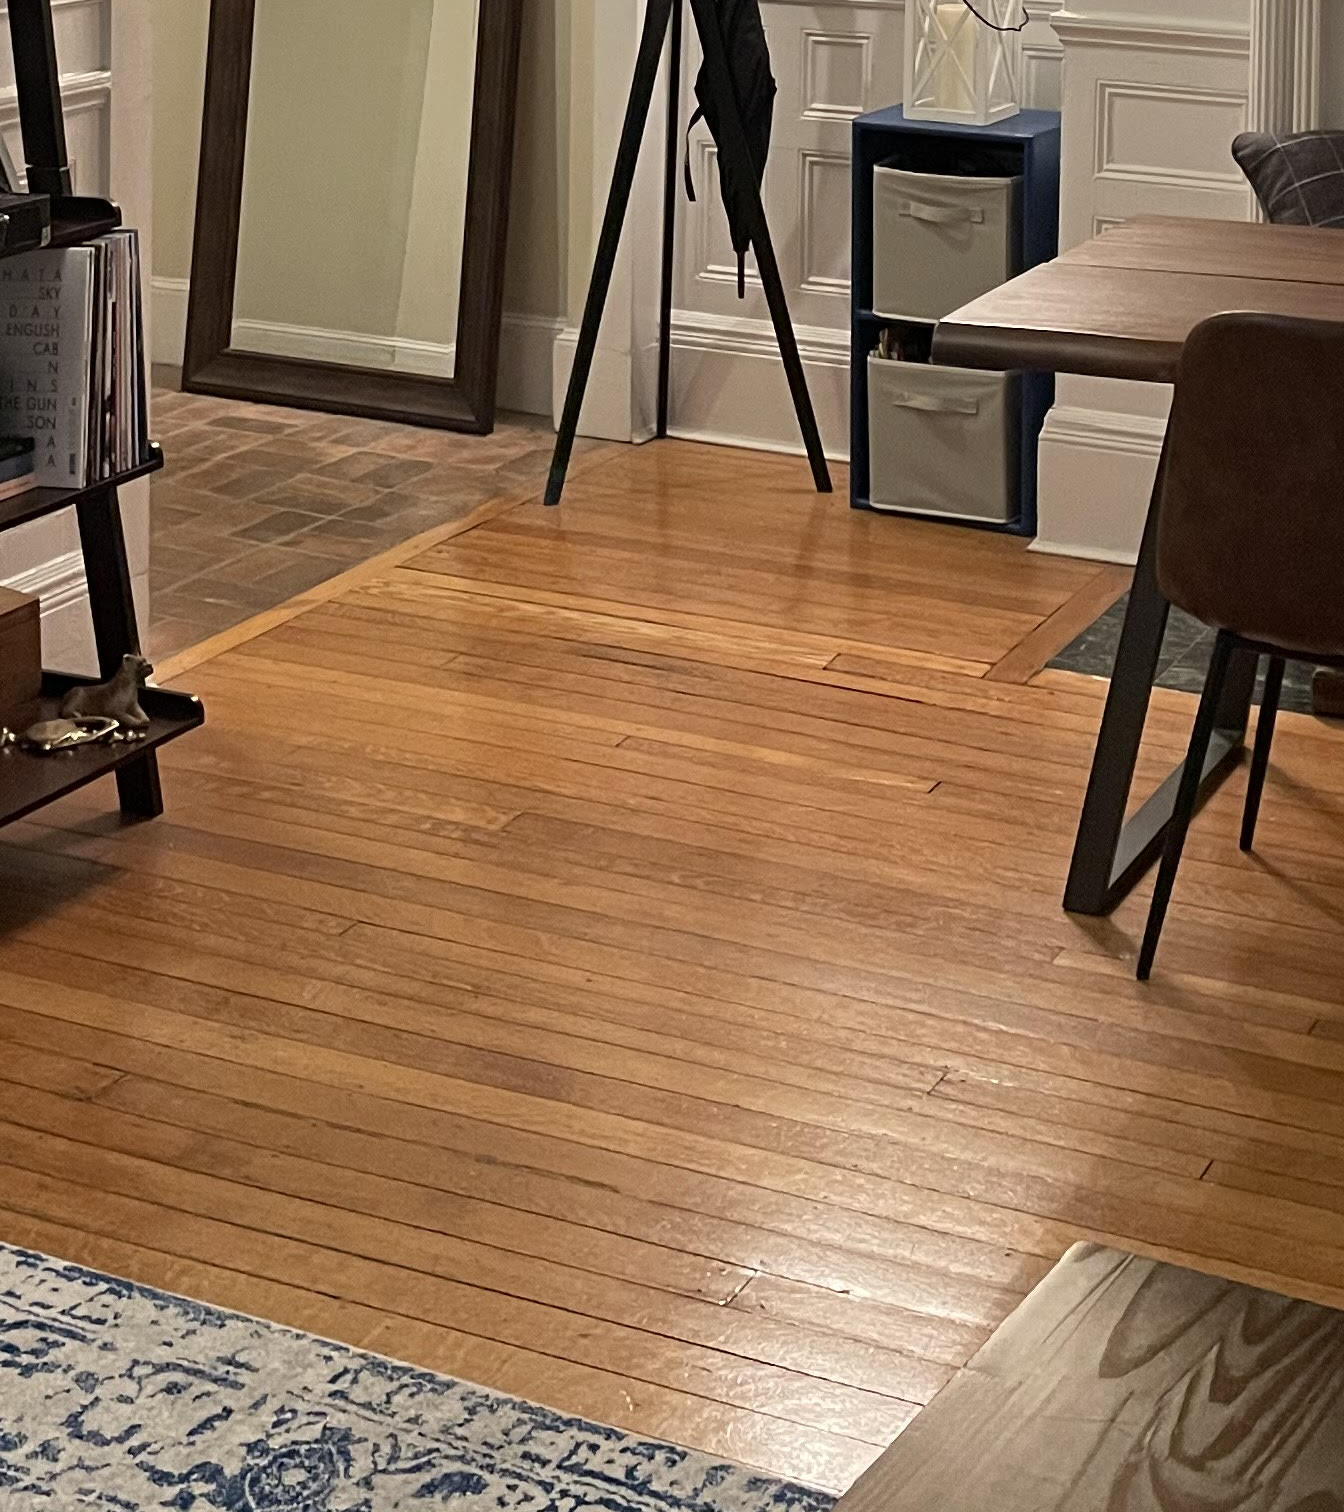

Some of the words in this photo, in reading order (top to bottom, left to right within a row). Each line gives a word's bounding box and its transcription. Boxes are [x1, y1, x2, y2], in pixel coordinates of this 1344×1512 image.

[38, 286, 62, 300] SKY
[6, 322, 60, 337] ENGLISH
[32, 341, 59, 356] CAB
[26, 396, 57, 411] GUN
